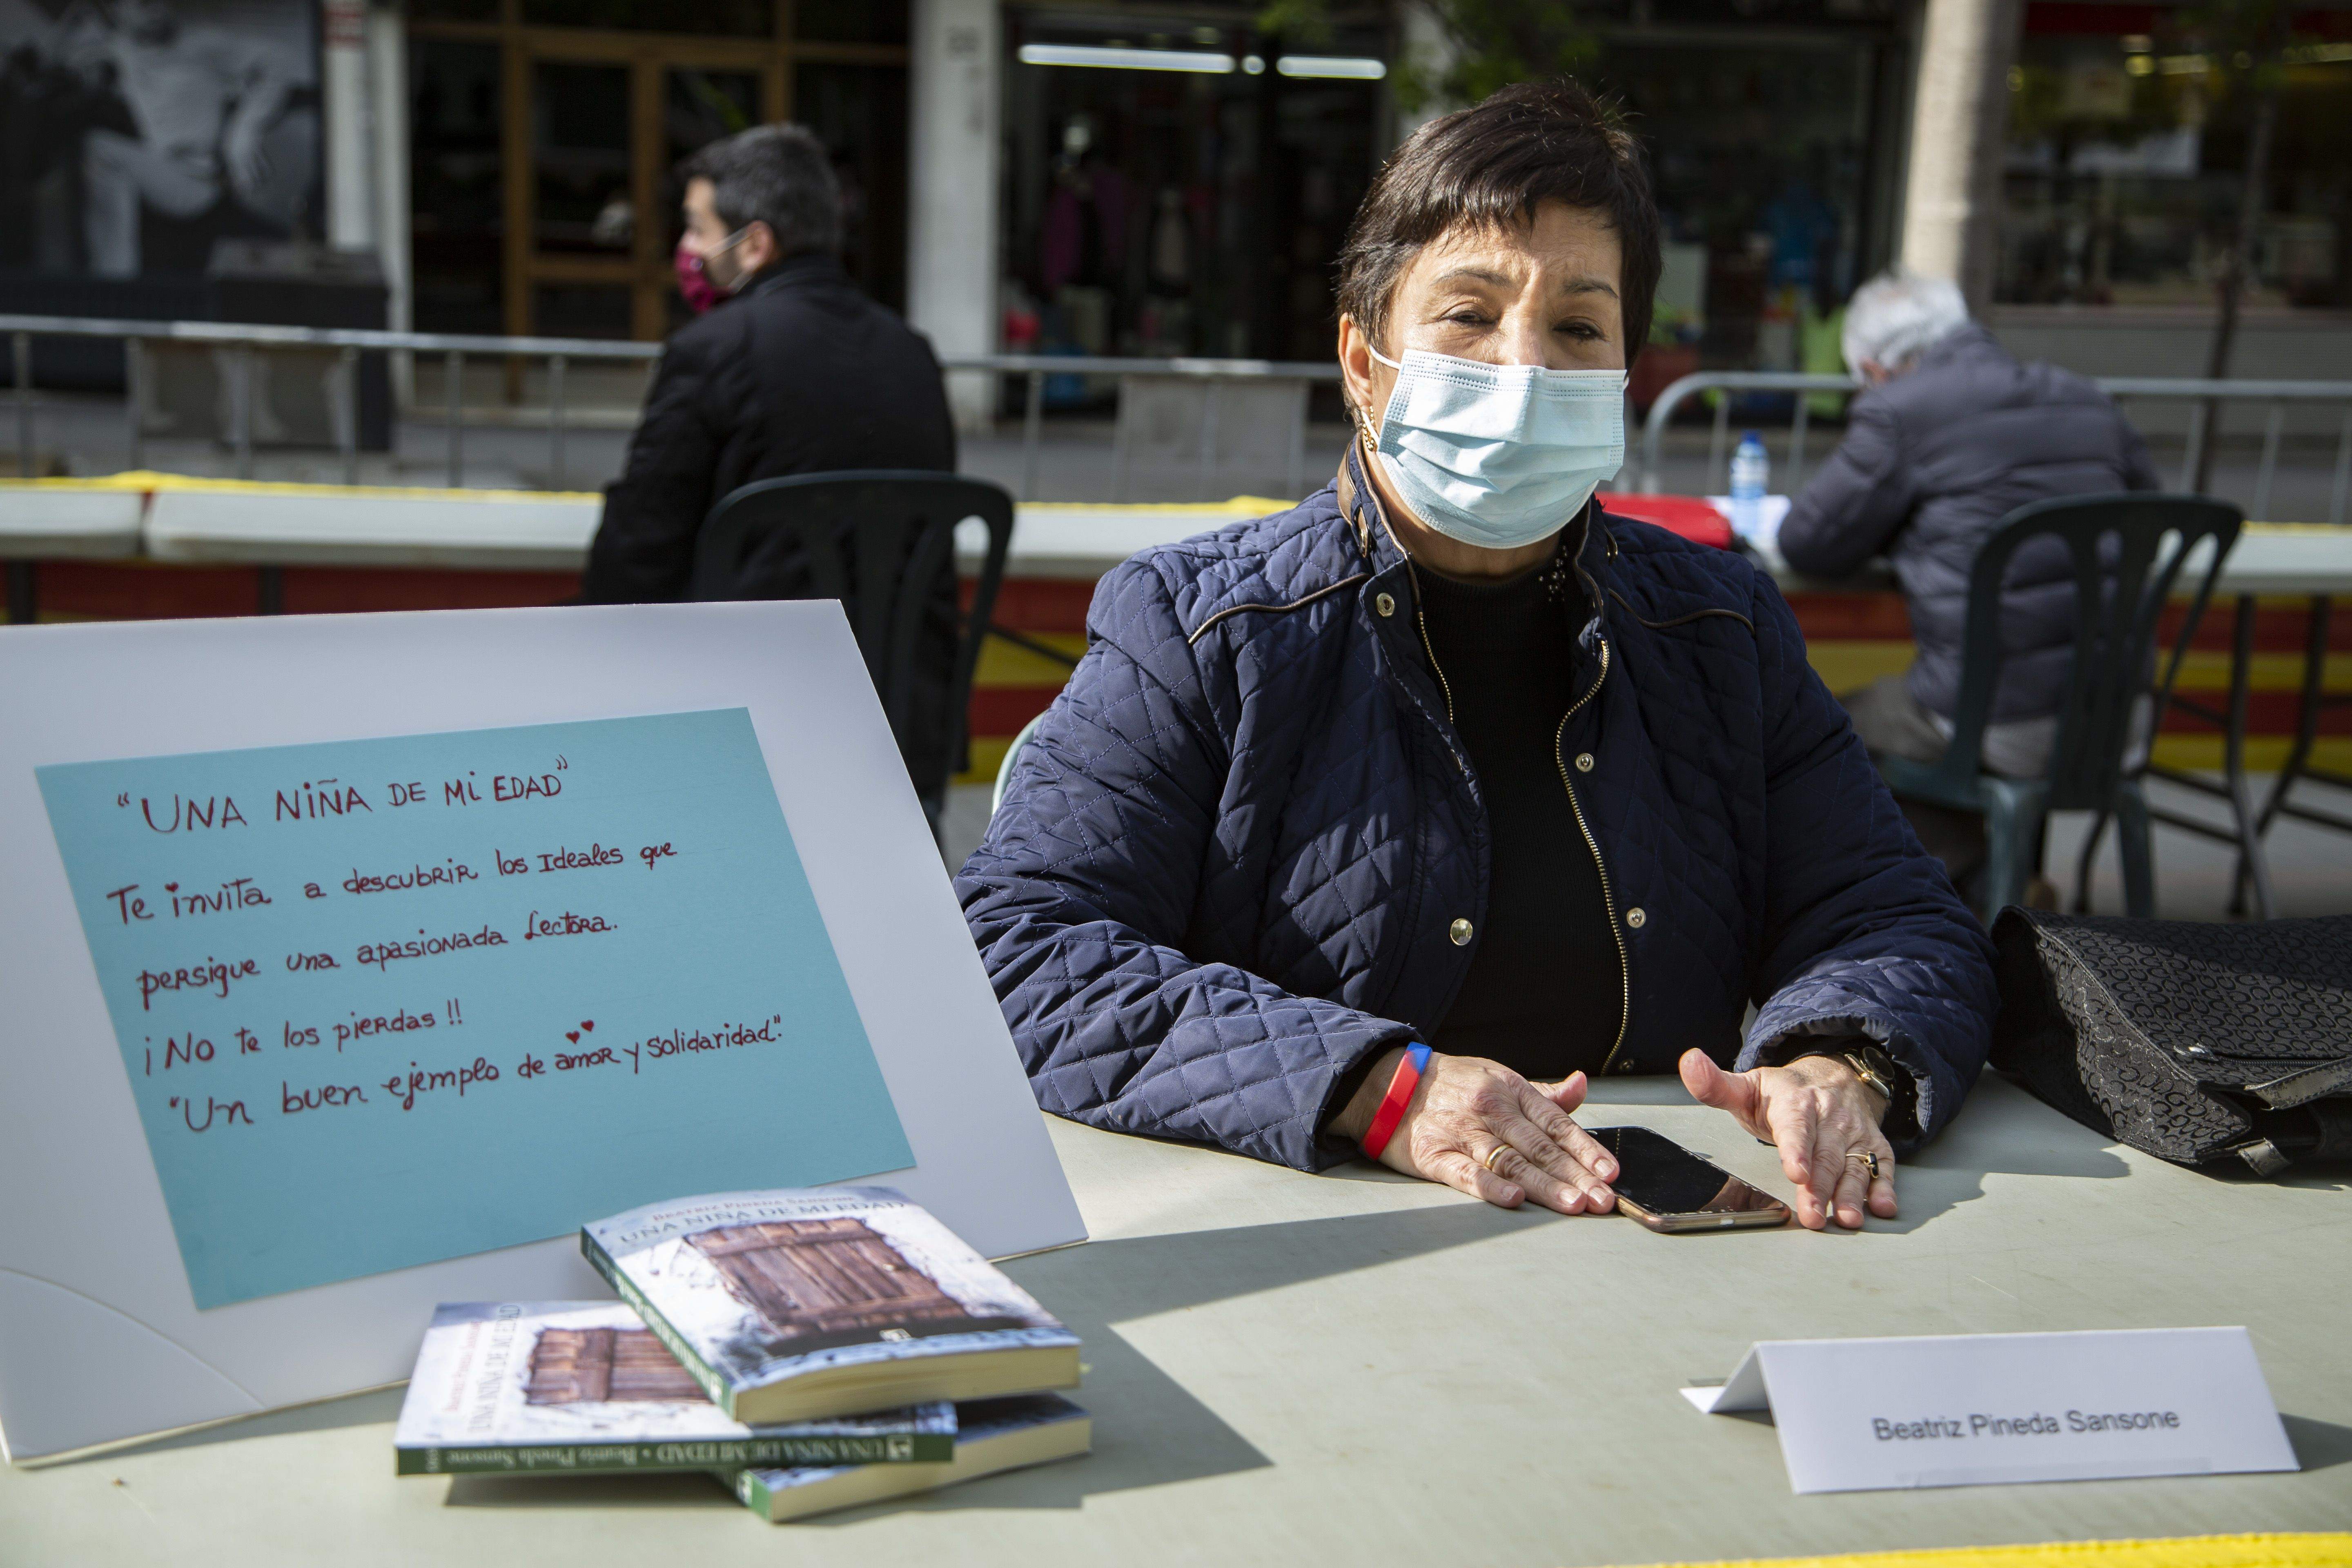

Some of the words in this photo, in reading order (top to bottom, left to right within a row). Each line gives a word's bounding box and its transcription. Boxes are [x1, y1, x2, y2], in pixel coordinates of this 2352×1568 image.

[388, 782, 426, 807] DE
[106, 884, 154, 924] Te
[164, 877, 272, 918] invita
[304, 882, 326, 899] a
[495, 848, 529, 875] los
[639, 842, 677, 870] que
[136, 956, 260, 1011] persigue
[285, 953, 340, 971] una
[356, 924, 508, 971] apasionada
[234, 1027, 261, 1055] te
[283, 1020, 320, 1048] los
[282, 1081, 368, 1115] buen
[381, 1057, 500, 1111] ejemplo
[517, 1054, 546, 1079] de
[555, 1047, 621, 1071] amor
[623, 1042, 639, 1074] y
[1872, 1416, 1965, 1441] Beatriz
[1968, 1412, 2060, 1437] Pineda
[2064, 1409, 2180, 1432] Sansone
